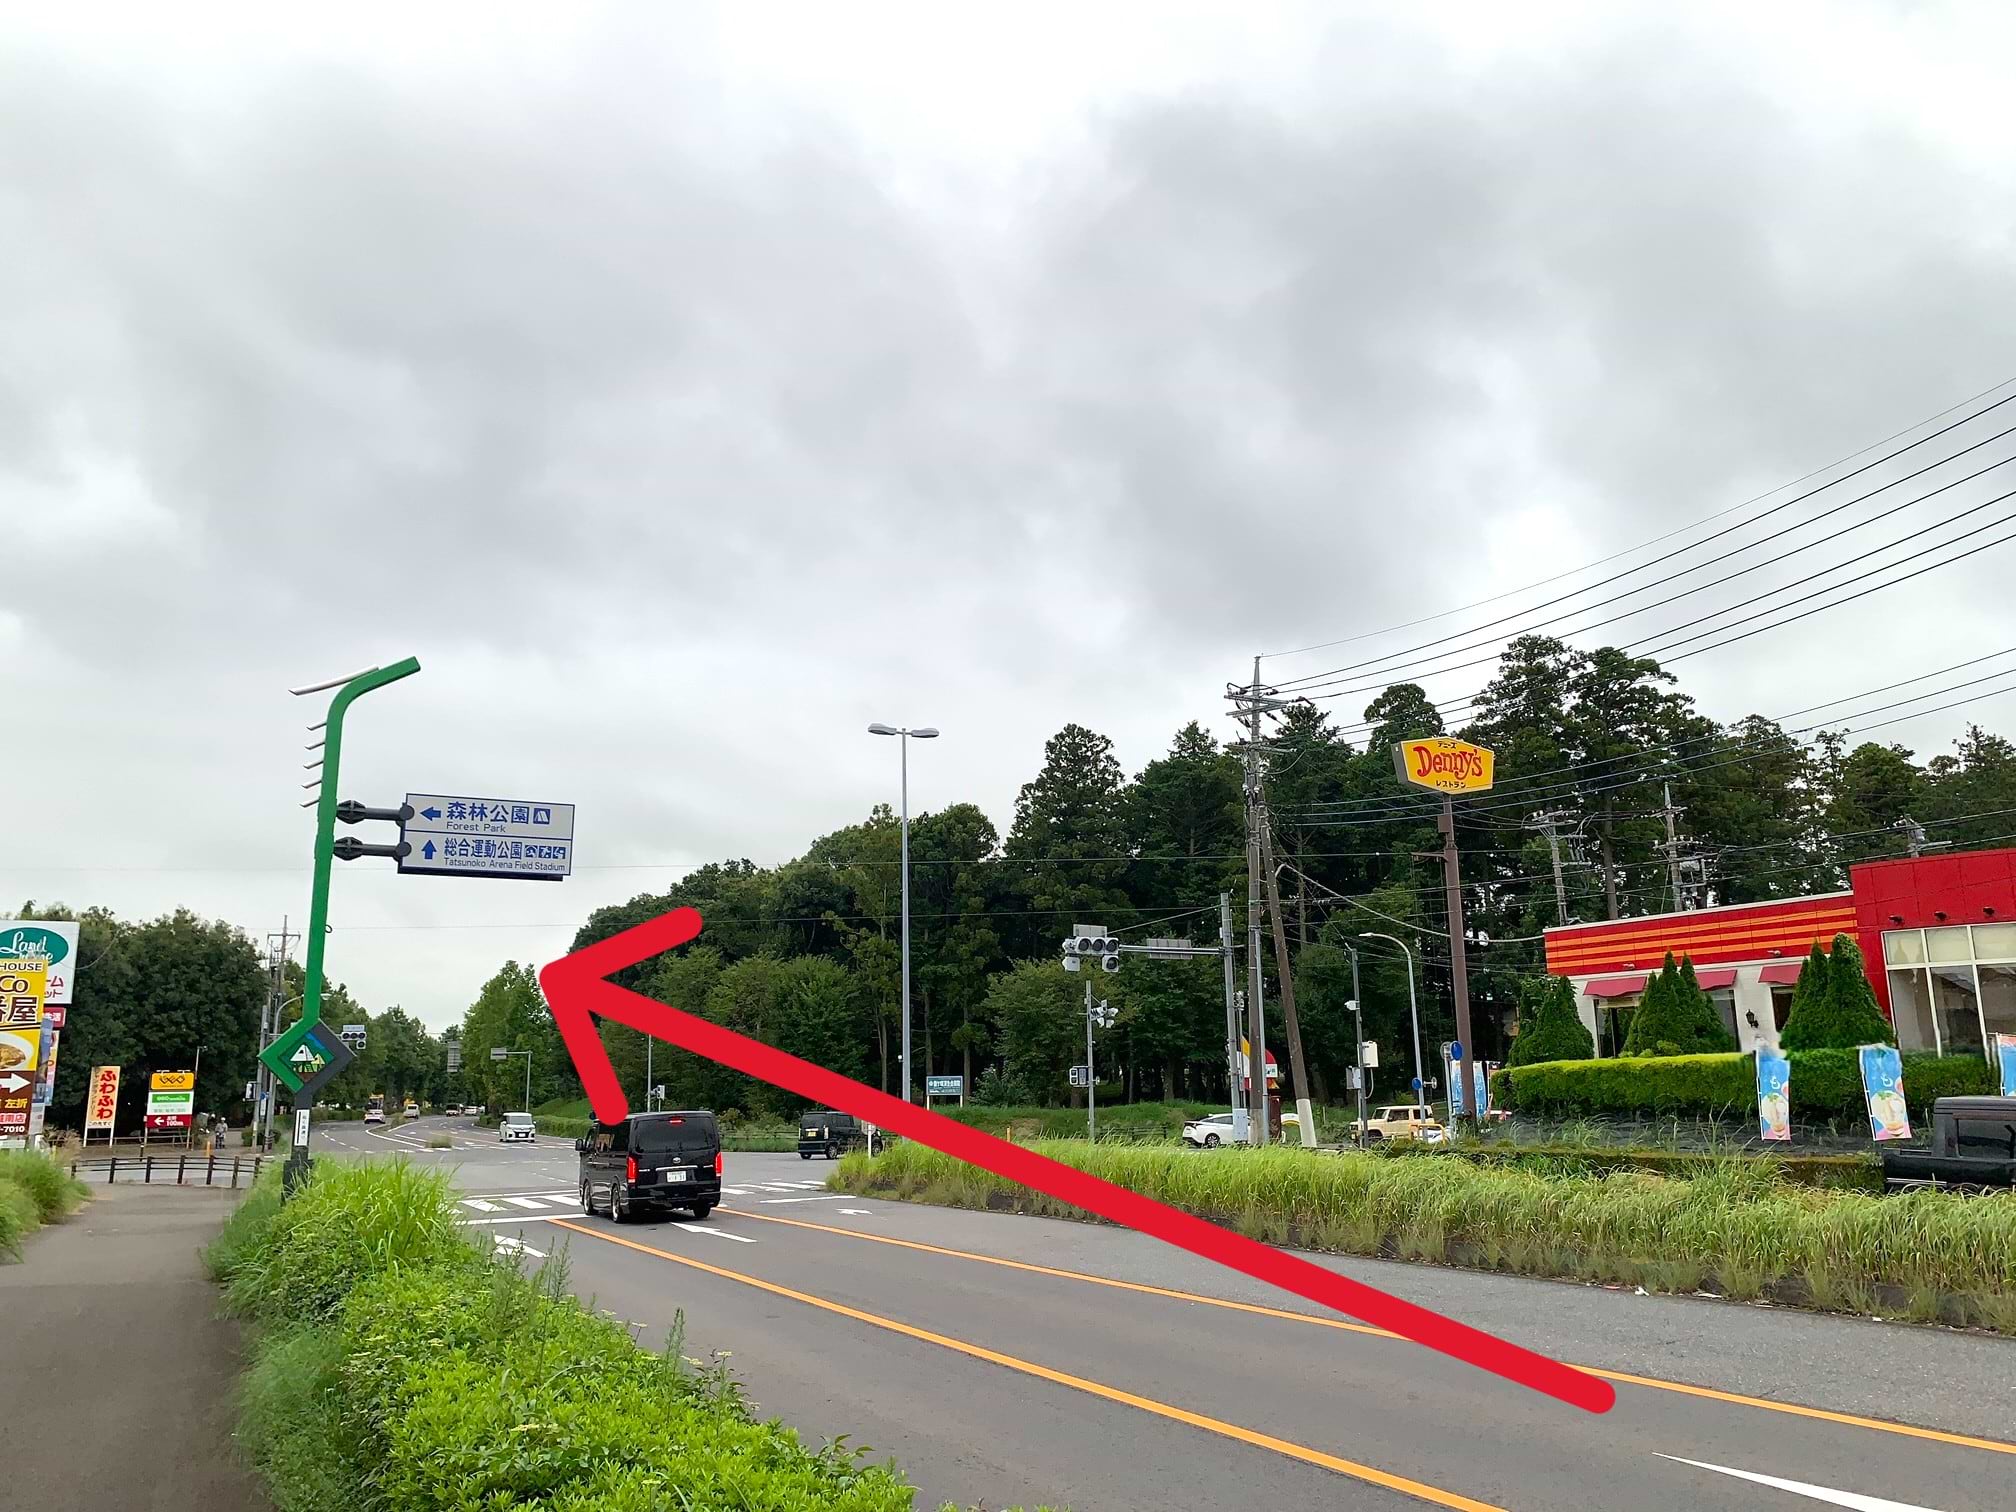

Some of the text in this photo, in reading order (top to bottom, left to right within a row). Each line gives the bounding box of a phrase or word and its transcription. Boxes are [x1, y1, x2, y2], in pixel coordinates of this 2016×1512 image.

[1413, 745, 1483, 780] Denny's
[1436, 780, 1467, 789] レストラン
[446, 801, 529, 824] 森林公園
[446, 821, 506, 833] Forest Park
[444, 837, 522, 860] 総合運動公園
[443, 857, 566, 872] Tatsunoko Arena Field Stadium
[0, 931, 47, 954] Land
[4, 1098, 28, 1109] 左折
[96, 1070, 117, 1120] ふわふわ
